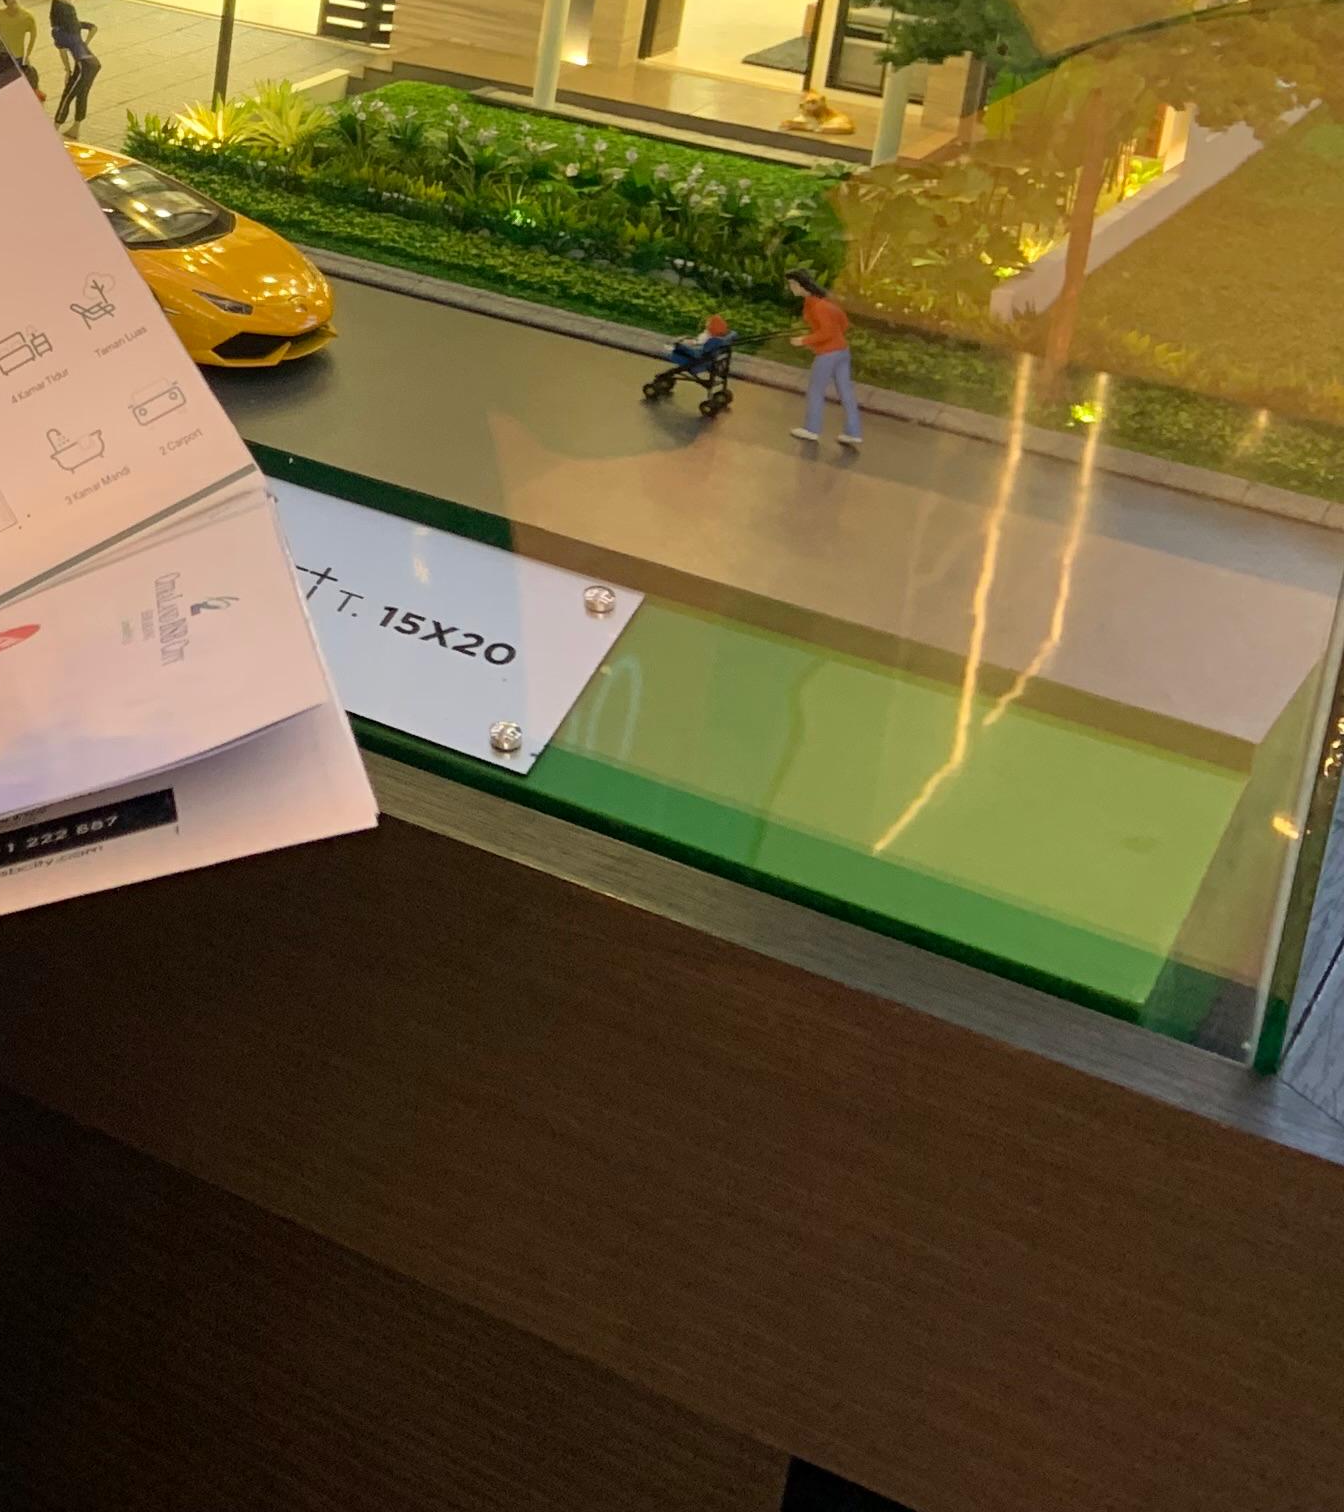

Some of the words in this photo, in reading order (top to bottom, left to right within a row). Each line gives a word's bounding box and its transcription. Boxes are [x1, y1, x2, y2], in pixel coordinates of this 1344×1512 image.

[94, 340, 125, 359] Taman
[127, 326, 147, 343] Luas
[18, 380, 45, 400] Kamar
[46, 368, 69, 386] Tidur
[167, 428, 203, 452] Carport
[73, 480, 101, 500] Kamar
[102, 466, 131, 487] Mandi
[379, 606, 516, 665] 15X20
[27, 828, 73, 850] 222
